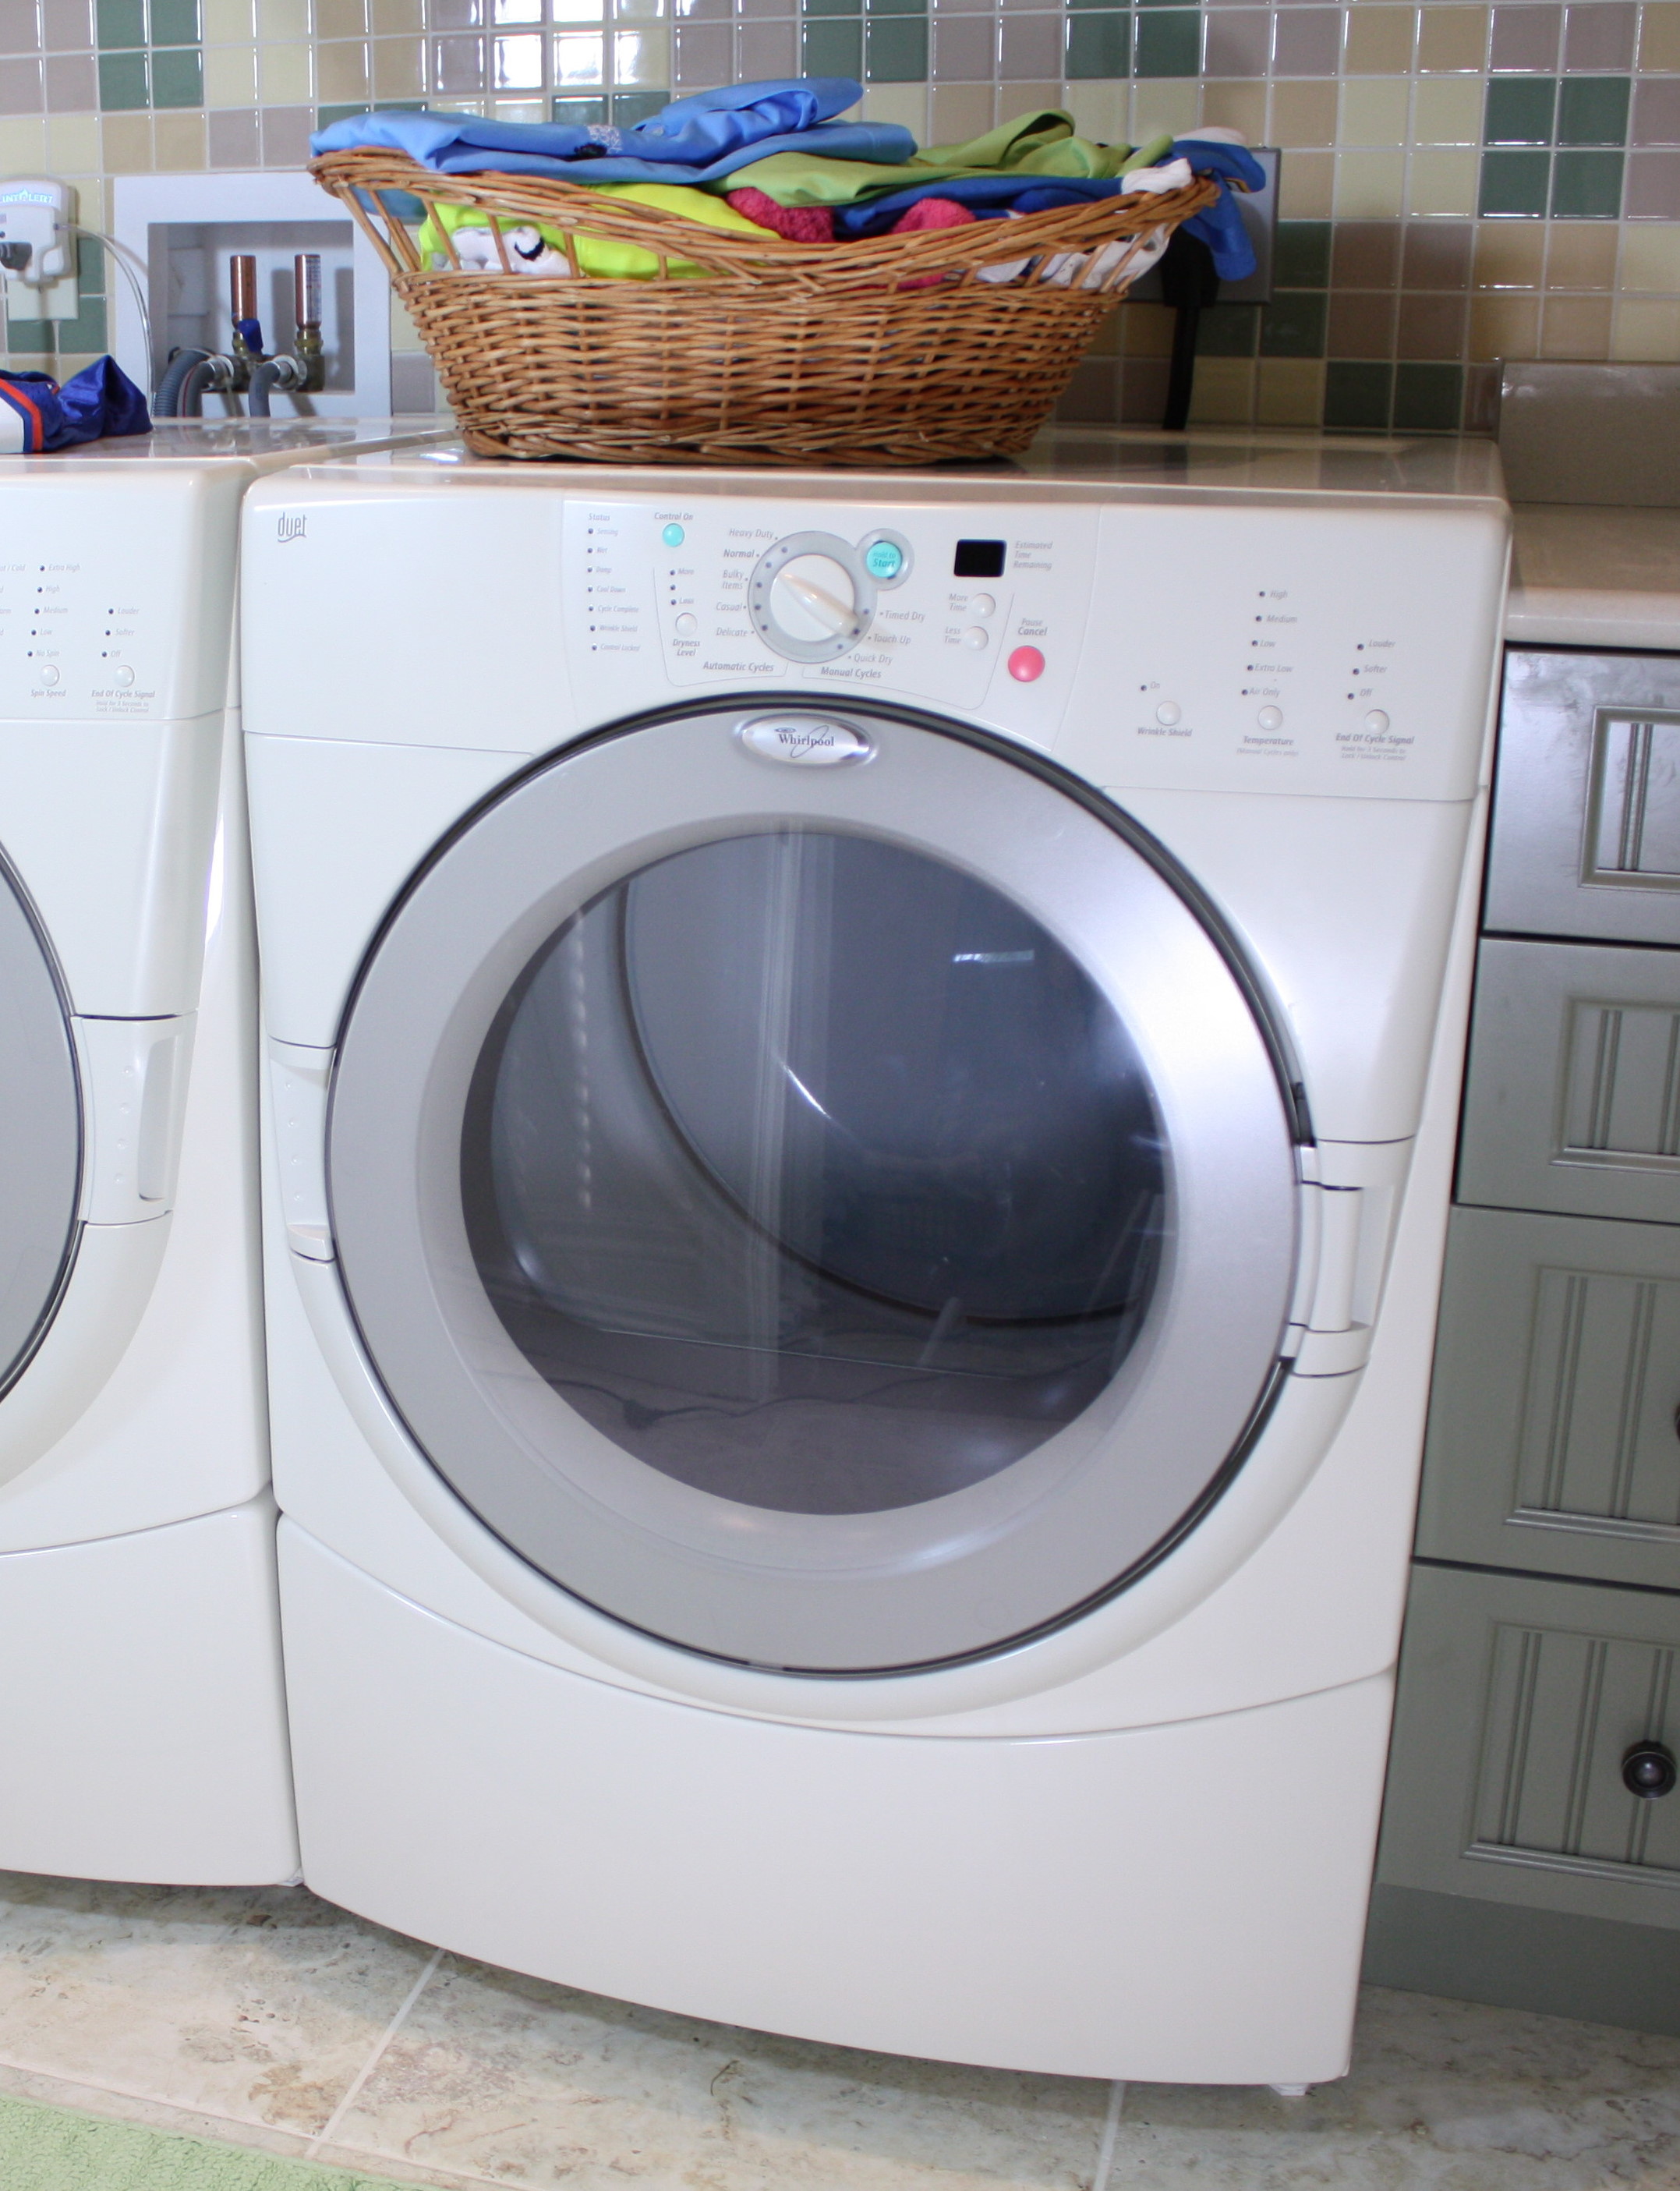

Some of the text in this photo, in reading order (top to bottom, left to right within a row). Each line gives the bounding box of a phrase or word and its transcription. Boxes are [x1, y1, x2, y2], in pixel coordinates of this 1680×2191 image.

[2, 188, 53, 204] INTALERT
[589, 513, 610, 522] Status
[654, 512, 681, 521] Control
[277, 511, 307, 541] duet
[729, 528, 773, 540] Heavy Duty
[1014, 540, 1053, 550] Estimated
[723, 549, 755, 558] Normal
[1014, 550, 1031, 559] Time
[873, 557, 896, 568] Start
[1013, 561, 1052, 571] Remaining
[65, 564, 80, 573] High
[723, 570, 743, 580] Bulky
[45, 585, 60, 594] High
[722, 581, 743, 590] Items
[949, 593, 968, 602] More
[1270, 590, 1288, 599] High
[716, 602, 742, 611] Casual
[949, 603, 967, 612] Time
[885, 611, 925, 623] Timed Dry
[1266, 614, 1298, 624] Medium
[1021, 618, 1042, 627] Pause
[716, 628, 748, 637] Delicate
[945, 626, 960, 635] Less
[1017, 626, 1048, 636] Cancel
[673, 639, 700, 649] Dryness
[873, 633, 911, 646] Touch Up
[944, 635, 960, 644] Time
[1368, 639, 1396, 648] Louder
[46, 650, 60, 658] Spin
[111, 650, 121, 658] Off
[854, 653, 893, 666] Quick Dry
[703, 662, 774, 673] Automatic Cycles
[1254, 664, 1293, 673] Extra Low
[1364, 664, 1388, 674] Softer
[821, 667, 882, 679] Manual Cycles
[1150, 681, 1161, 689] On
[30, 688, 66, 698] Spin Speed
[91, 689, 156, 700] End Of Cycle Signal
[1250, 687, 1281, 699] Air Only
[1360, 688, 1372, 697] Off
[1137, 727, 1192, 737] Wrinkle Shield
[778, 733, 834, 748] Whirlpool
[1243, 735, 1295, 746] Temperature
[1335, 733, 1351, 742] End
[1365, 734, 1385, 745] Cycle
[1388, 735, 1414, 746] Signal
